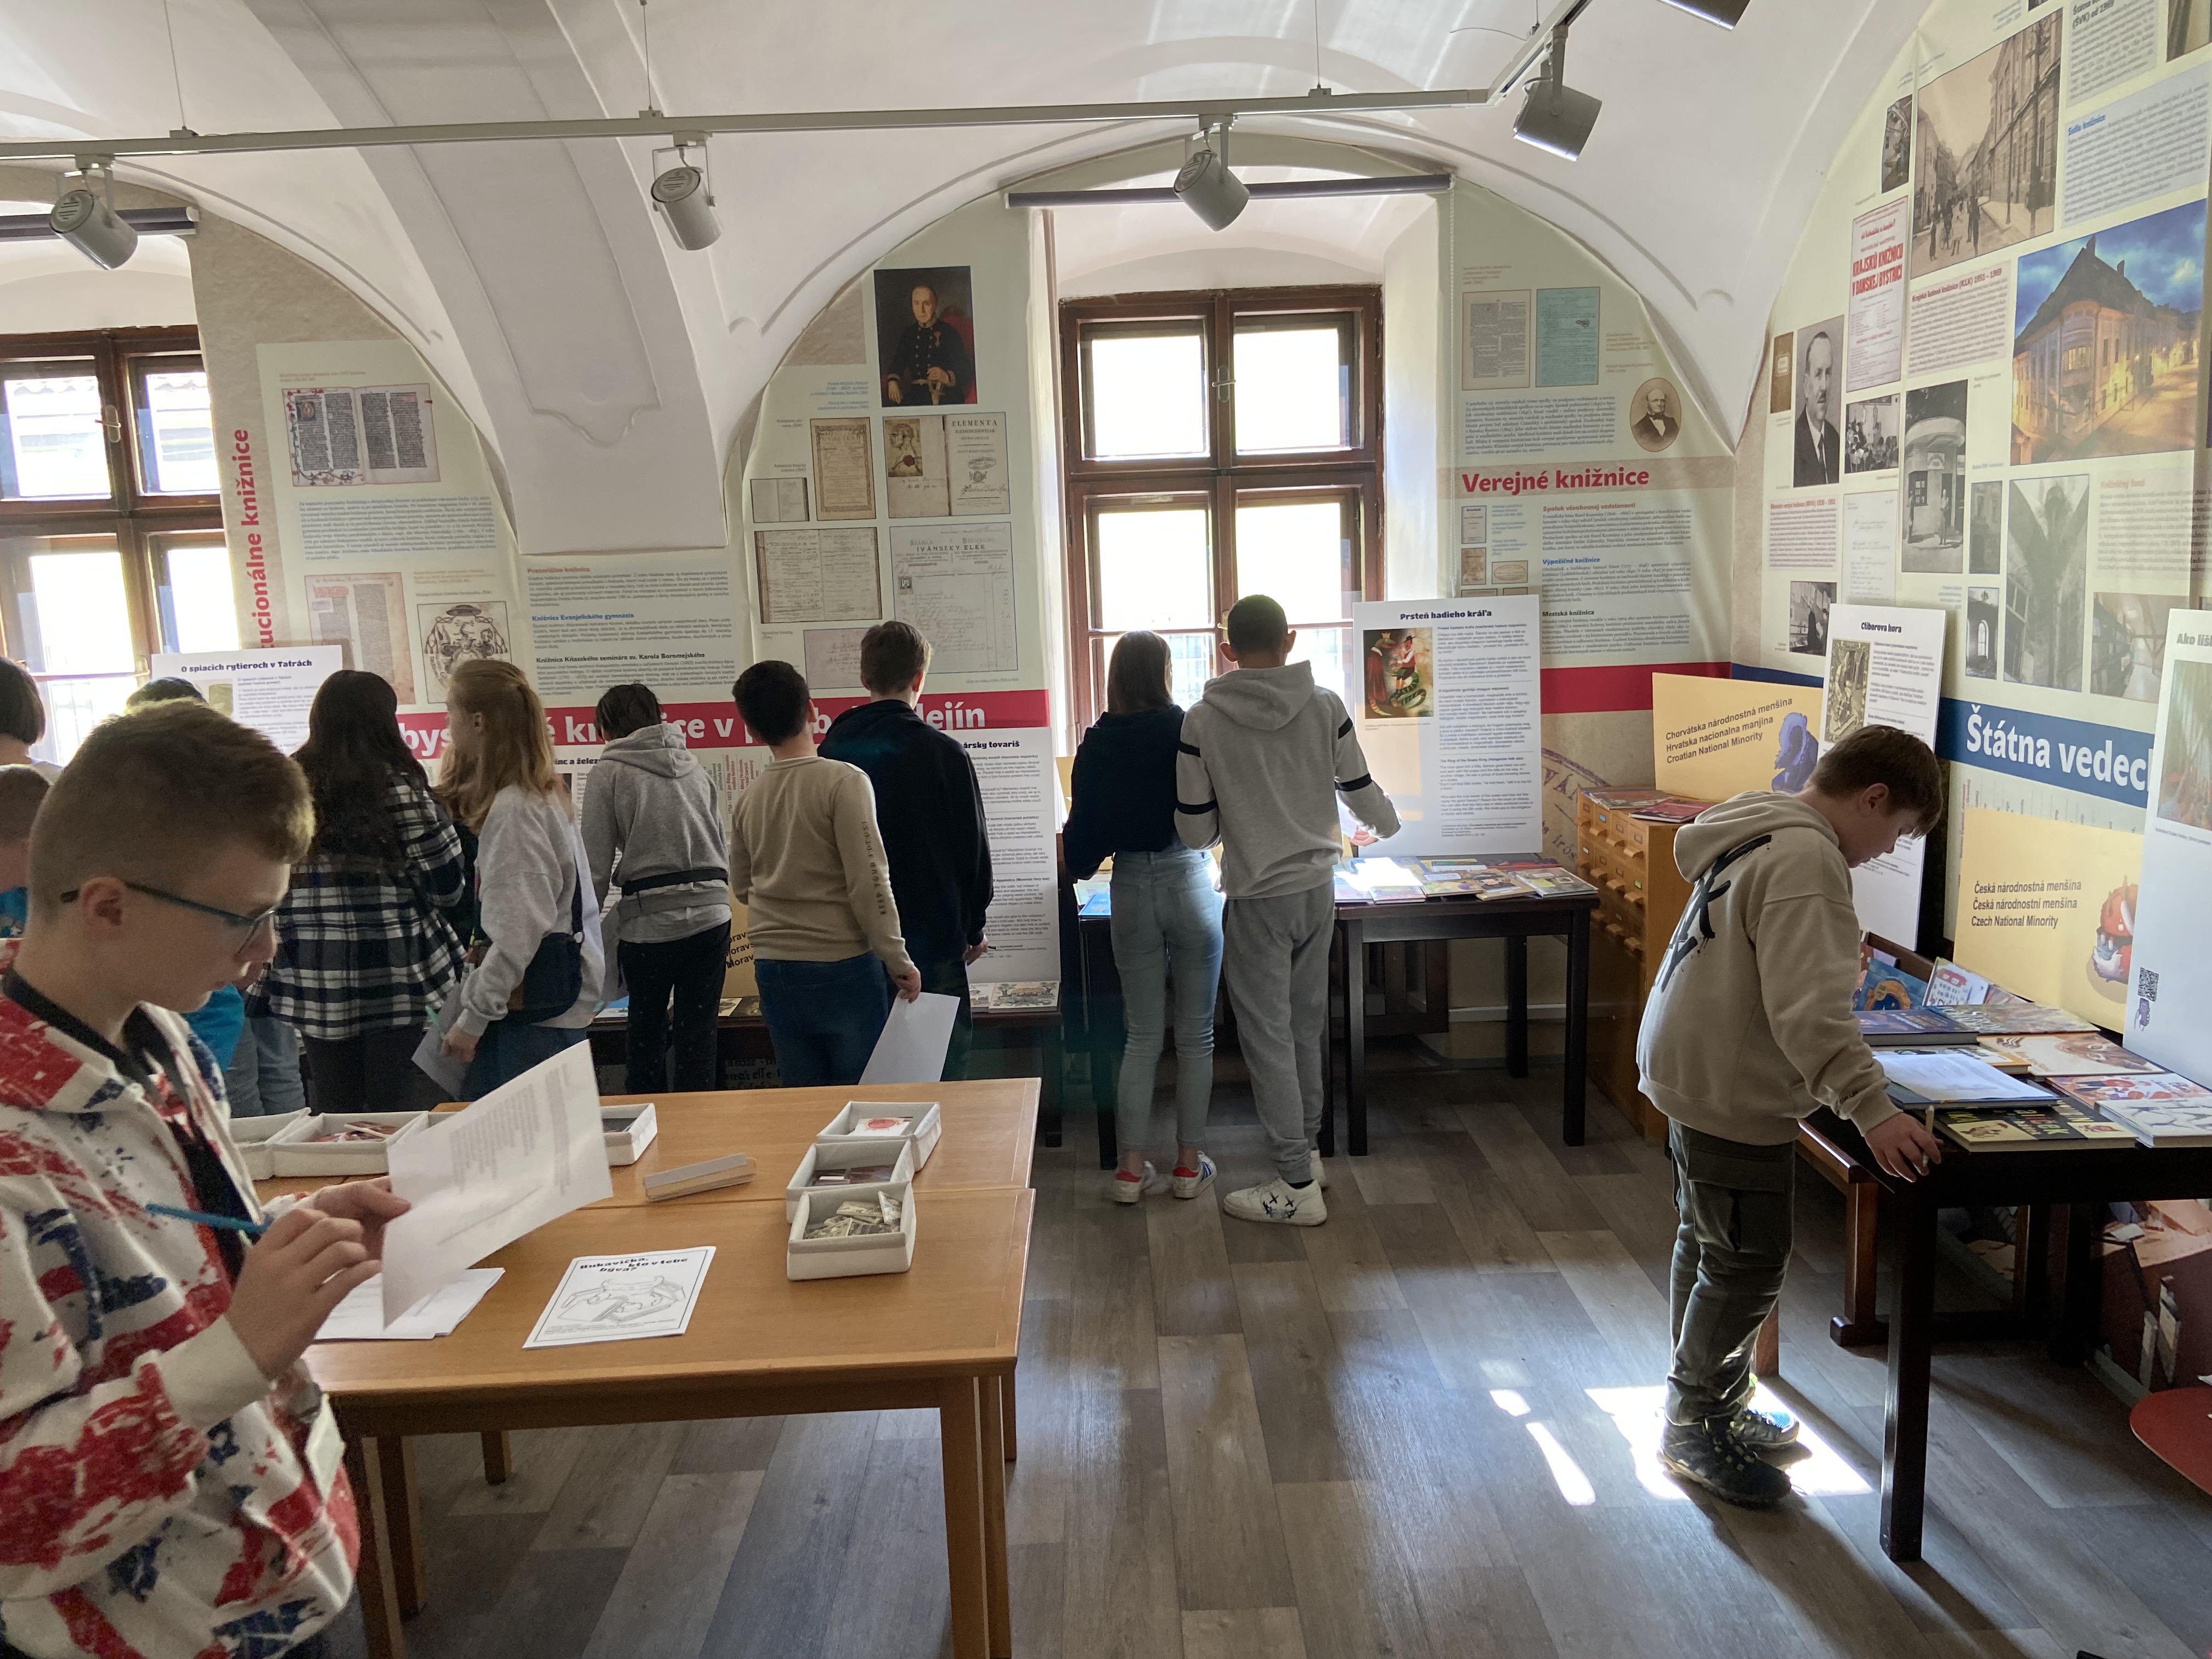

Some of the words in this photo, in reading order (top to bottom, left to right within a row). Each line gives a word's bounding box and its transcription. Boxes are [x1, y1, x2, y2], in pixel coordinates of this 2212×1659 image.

[232, 429, 260, 526] knižnice
[1462, 471, 1549, 495] Verejné
[1555, 467, 1650, 489] knižnice
[245, 533, 275, 648] ucionálne
[1861, 622, 1887, 632] Ctiborova
[1888, 623, 1901, 633] hora
[2177, 633, 2196, 645] Ako
[189, 664, 224, 672] spiacich
[227, 662, 268, 670] rytieroch
[714, 717, 733, 738] v
[1666, 724, 1706, 740] Chorvátska
[1708, 707, 1756, 729] národnostná
[1758, 698, 1792, 714] menšina
[1666, 738, 1697, 752] Hrvatska
[1699, 725, 1740, 743] nacionalna
[1742, 716, 1773, 731] manjina
[1667, 751, 1697, 764] Croatian
[1699, 741, 1729, 755] National
[1731, 731, 1763, 746] Minority
[1966, 704, 2051, 769] Štátna
[870, 861, 881, 888] YOUR
[1974, 881, 1995, 894] Česká
[1997, 880, 2044, 893] národnostná
[2047, 879, 2081, 891] menšina
[1973, 897, 1994, 910] Česká
[1996, 898, 2040, 910] národnostní
[2043, 897, 2077, 909] menšina
[1972, 916, 1992, 926] Czech
[1994, 916, 2024, 926] National
[2027, 915, 2058, 929] Minority
